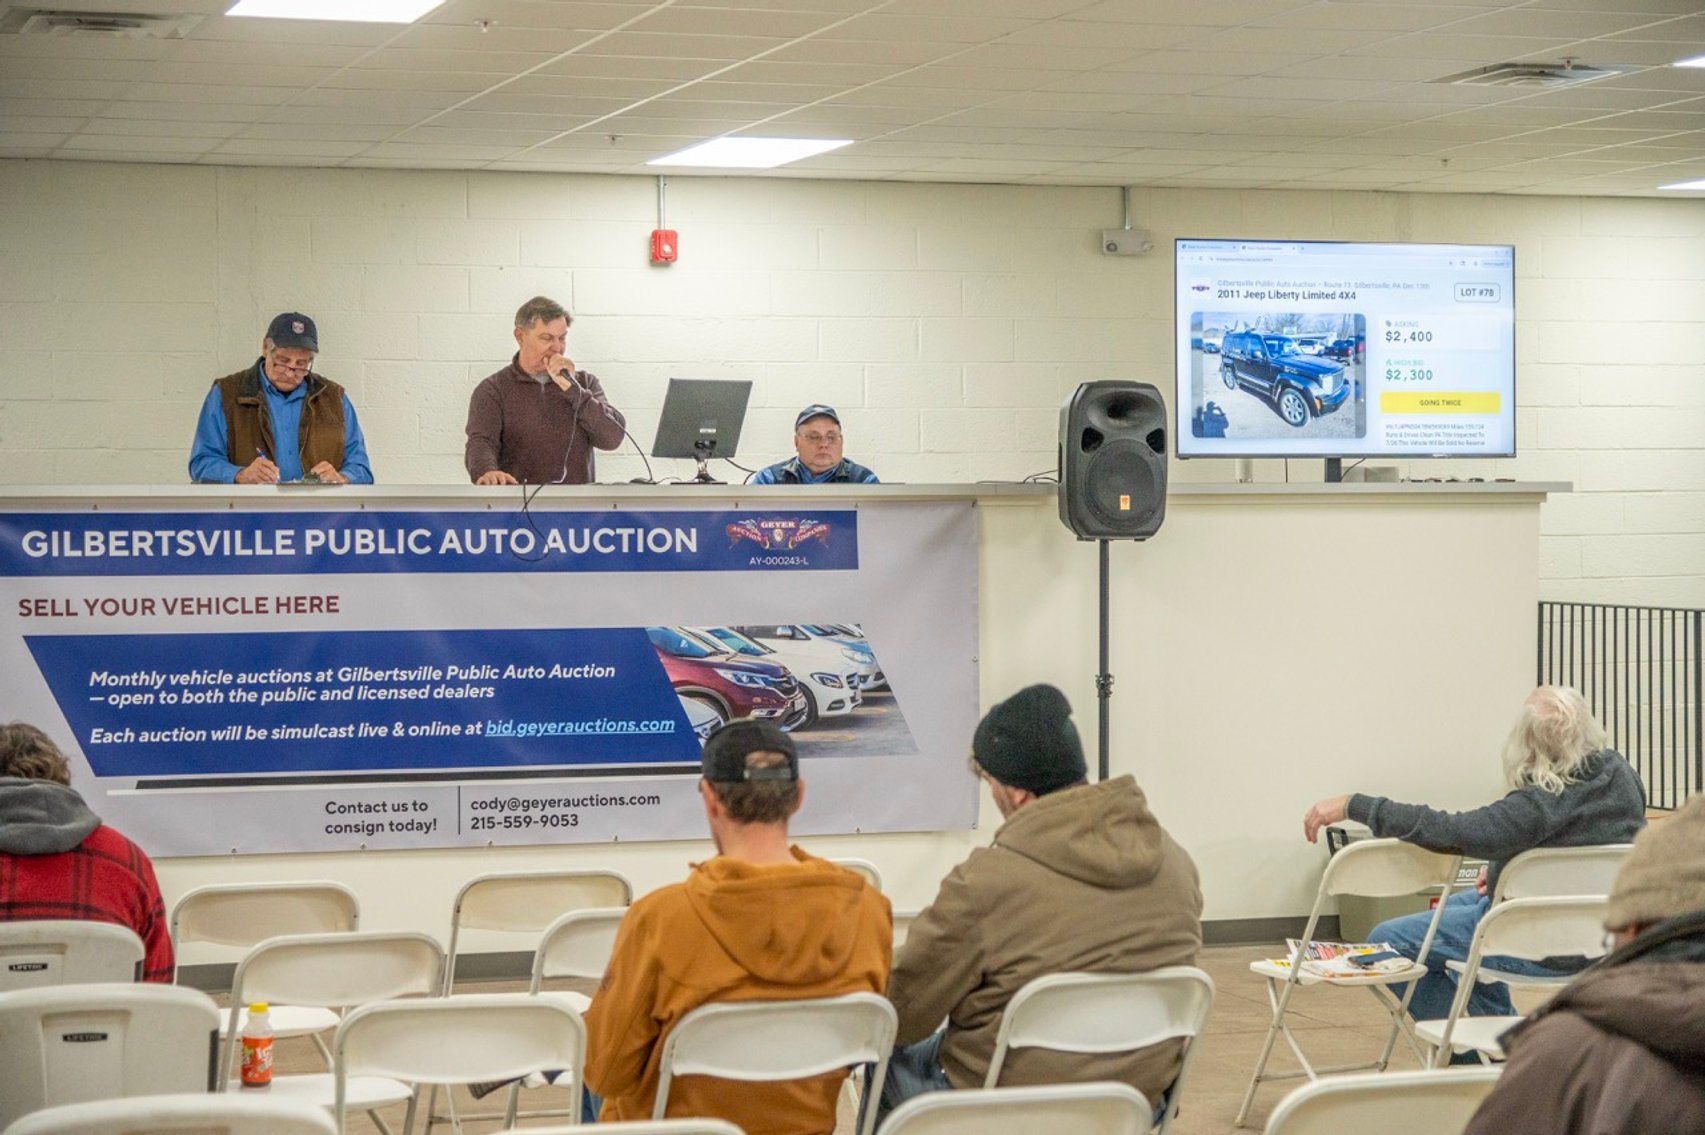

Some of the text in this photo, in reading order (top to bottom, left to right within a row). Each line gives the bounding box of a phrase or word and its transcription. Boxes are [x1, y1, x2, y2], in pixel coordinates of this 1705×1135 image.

[1217, 289, 1357, 301] 2011 Jeep Liberty Limited 4X4
[1461, 288, 1494, 297] LOT #78
[1385, 331, 1433, 343] $2,400
[1385, 369, 1433, 381] $2,300
[22, 528, 697, 557] GILBERTSVILLE PUBLIC AUTO AUCTION
[749, 556, 809, 565] AY-000243-L
[19, 596, 339, 617] SELL YOUR VEHICLE HERE
[90, 664, 615, 689] Monthly vehicle auctions at Gilbertsville Public Auto Auction
[108, 694, 154, 708] open
[159, 691, 178, 704] to
[182, 689, 224, 704] both
[229, 688, 258, 703] the
[261, 687, 316, 706] public
[320, 686, 354, 700] and
[357, 684, 430, 700] licensed
[433, 684, 494, 698] dealers
[90, 718, 675, 743] Each auction will be simulcast live & online at bid.geyerauctions.com
[325, 799, 429, 815] Contact us to
[471, 794, 660, 812] cody@geyerauctions.com
[325, 817, 439, 837] consign today!
[471, 814, 578, 829] 215-559-9053
